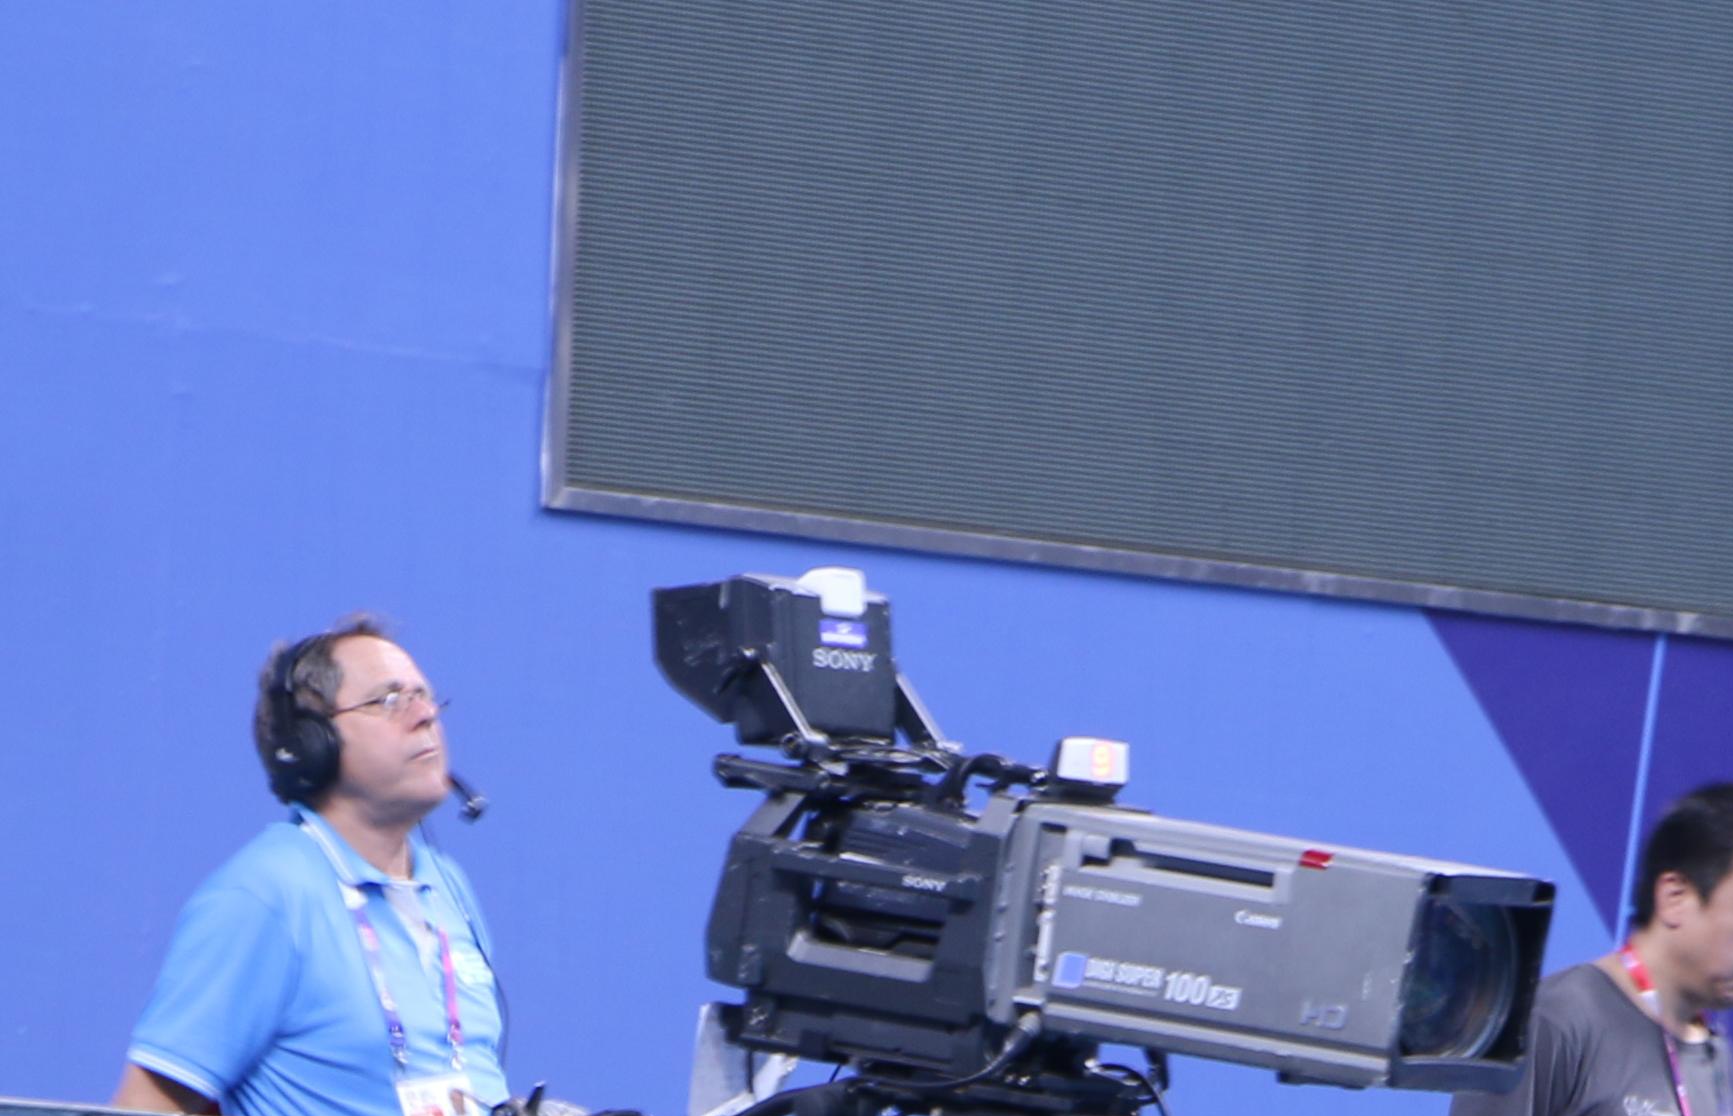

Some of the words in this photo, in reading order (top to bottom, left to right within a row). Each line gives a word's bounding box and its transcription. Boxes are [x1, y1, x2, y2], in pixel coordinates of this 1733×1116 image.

[812, 648, 876, 672] SONY
[902, 875, 947, 892] SONY
[1114, 963, 1164, 989] SUPER
[1164, 971, 1212, 1006] 100
[1299, 999, 1349, 1030] HD
